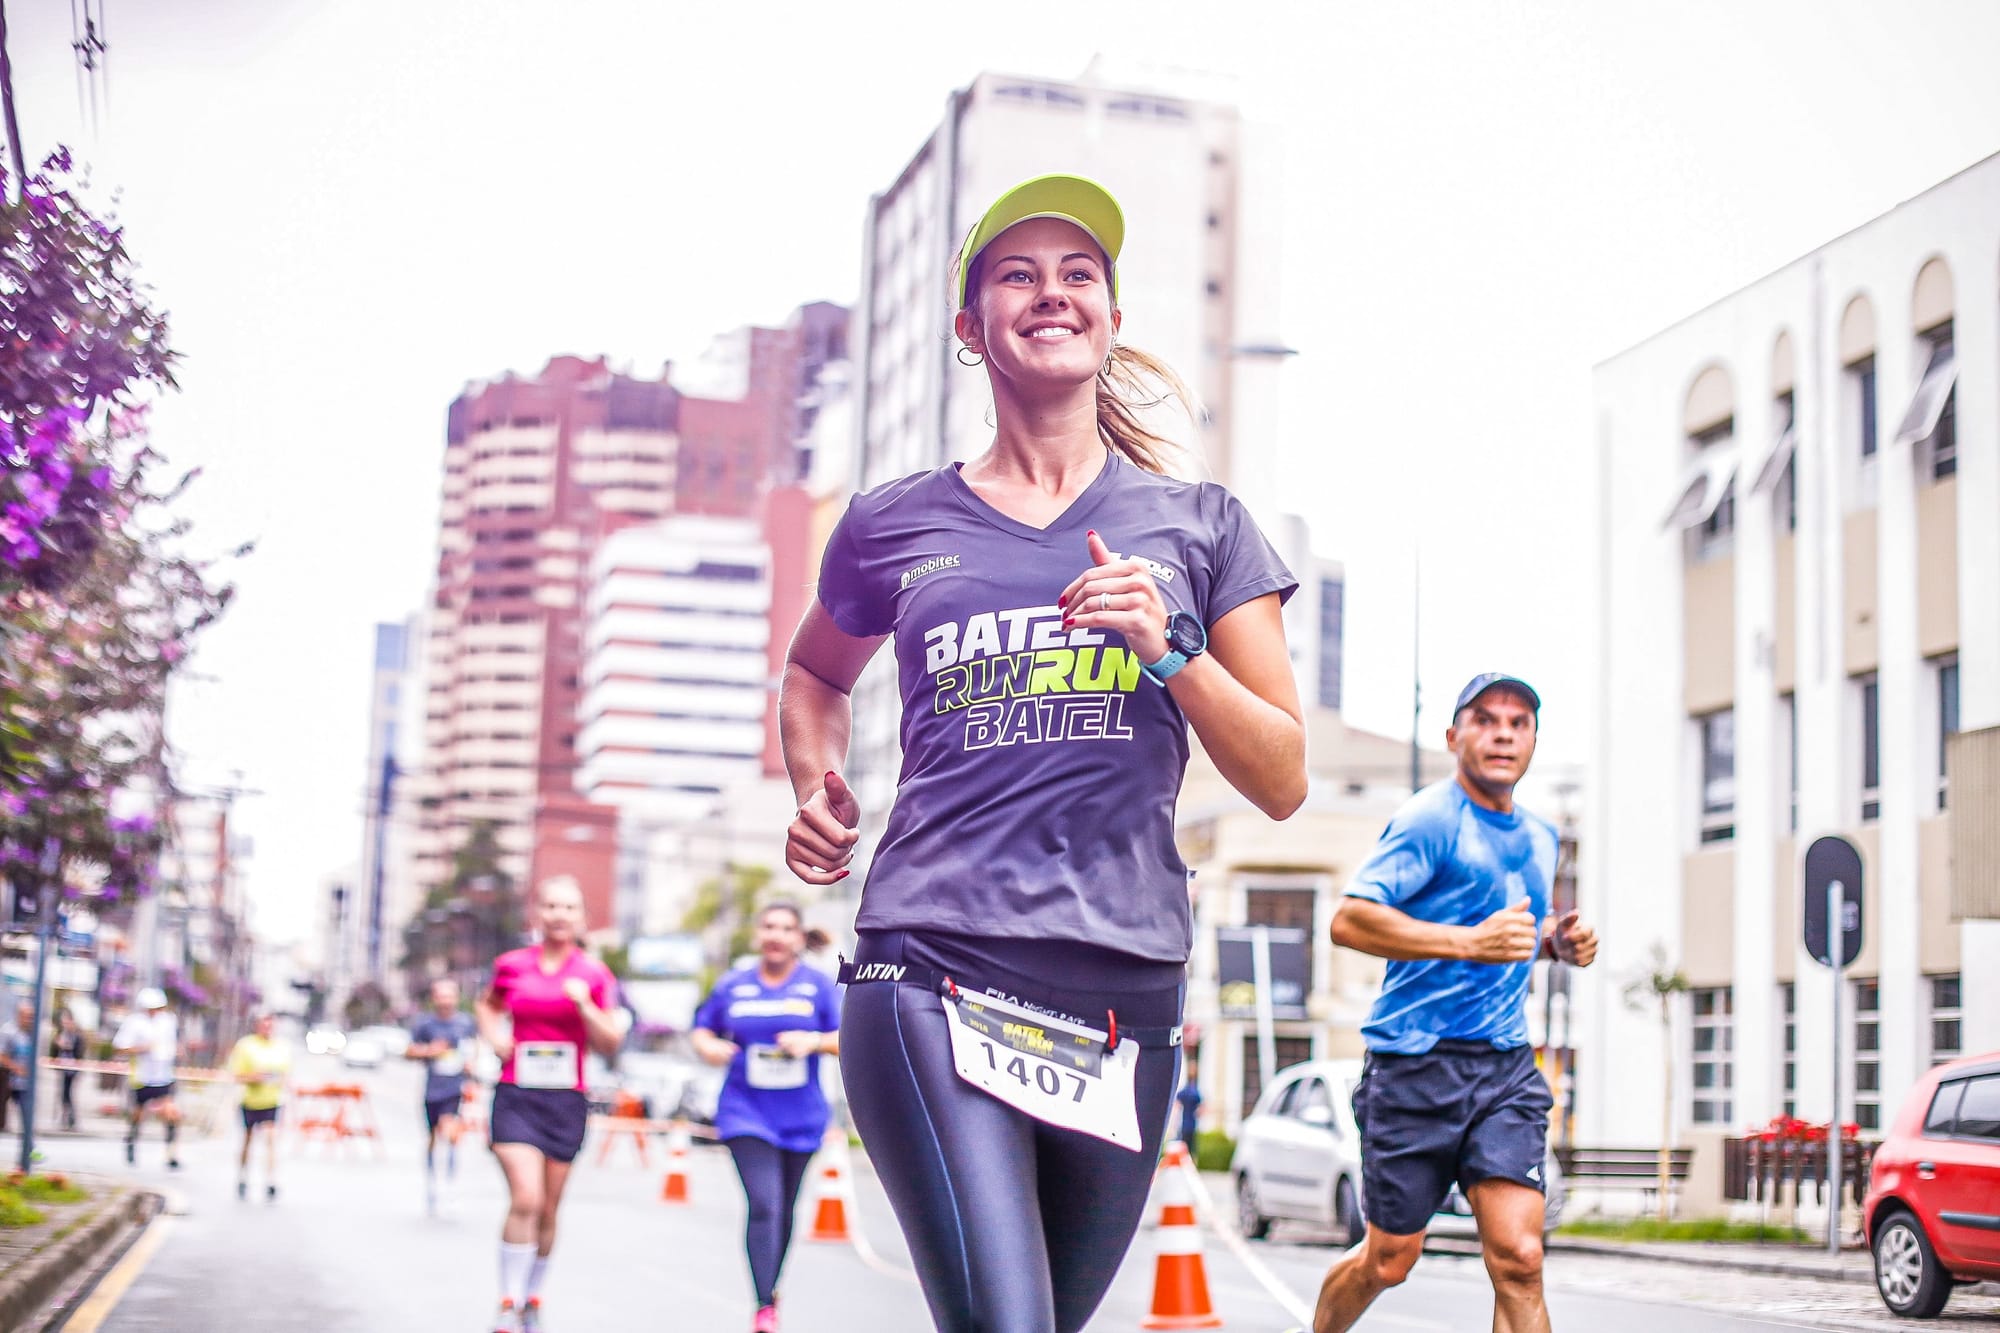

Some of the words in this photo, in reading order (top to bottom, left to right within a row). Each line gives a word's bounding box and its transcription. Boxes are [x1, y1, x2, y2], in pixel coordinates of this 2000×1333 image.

[910, 554, 960, 580] mobitec
[924, 605, 1106, 675] BATEL
[964, 693, 1134, 751] BATEL
[855, 963, 907, 981] LATIN
[986, 987, 1019, 1006] FILA
[981, 1042, 1087, 1103] 1407
